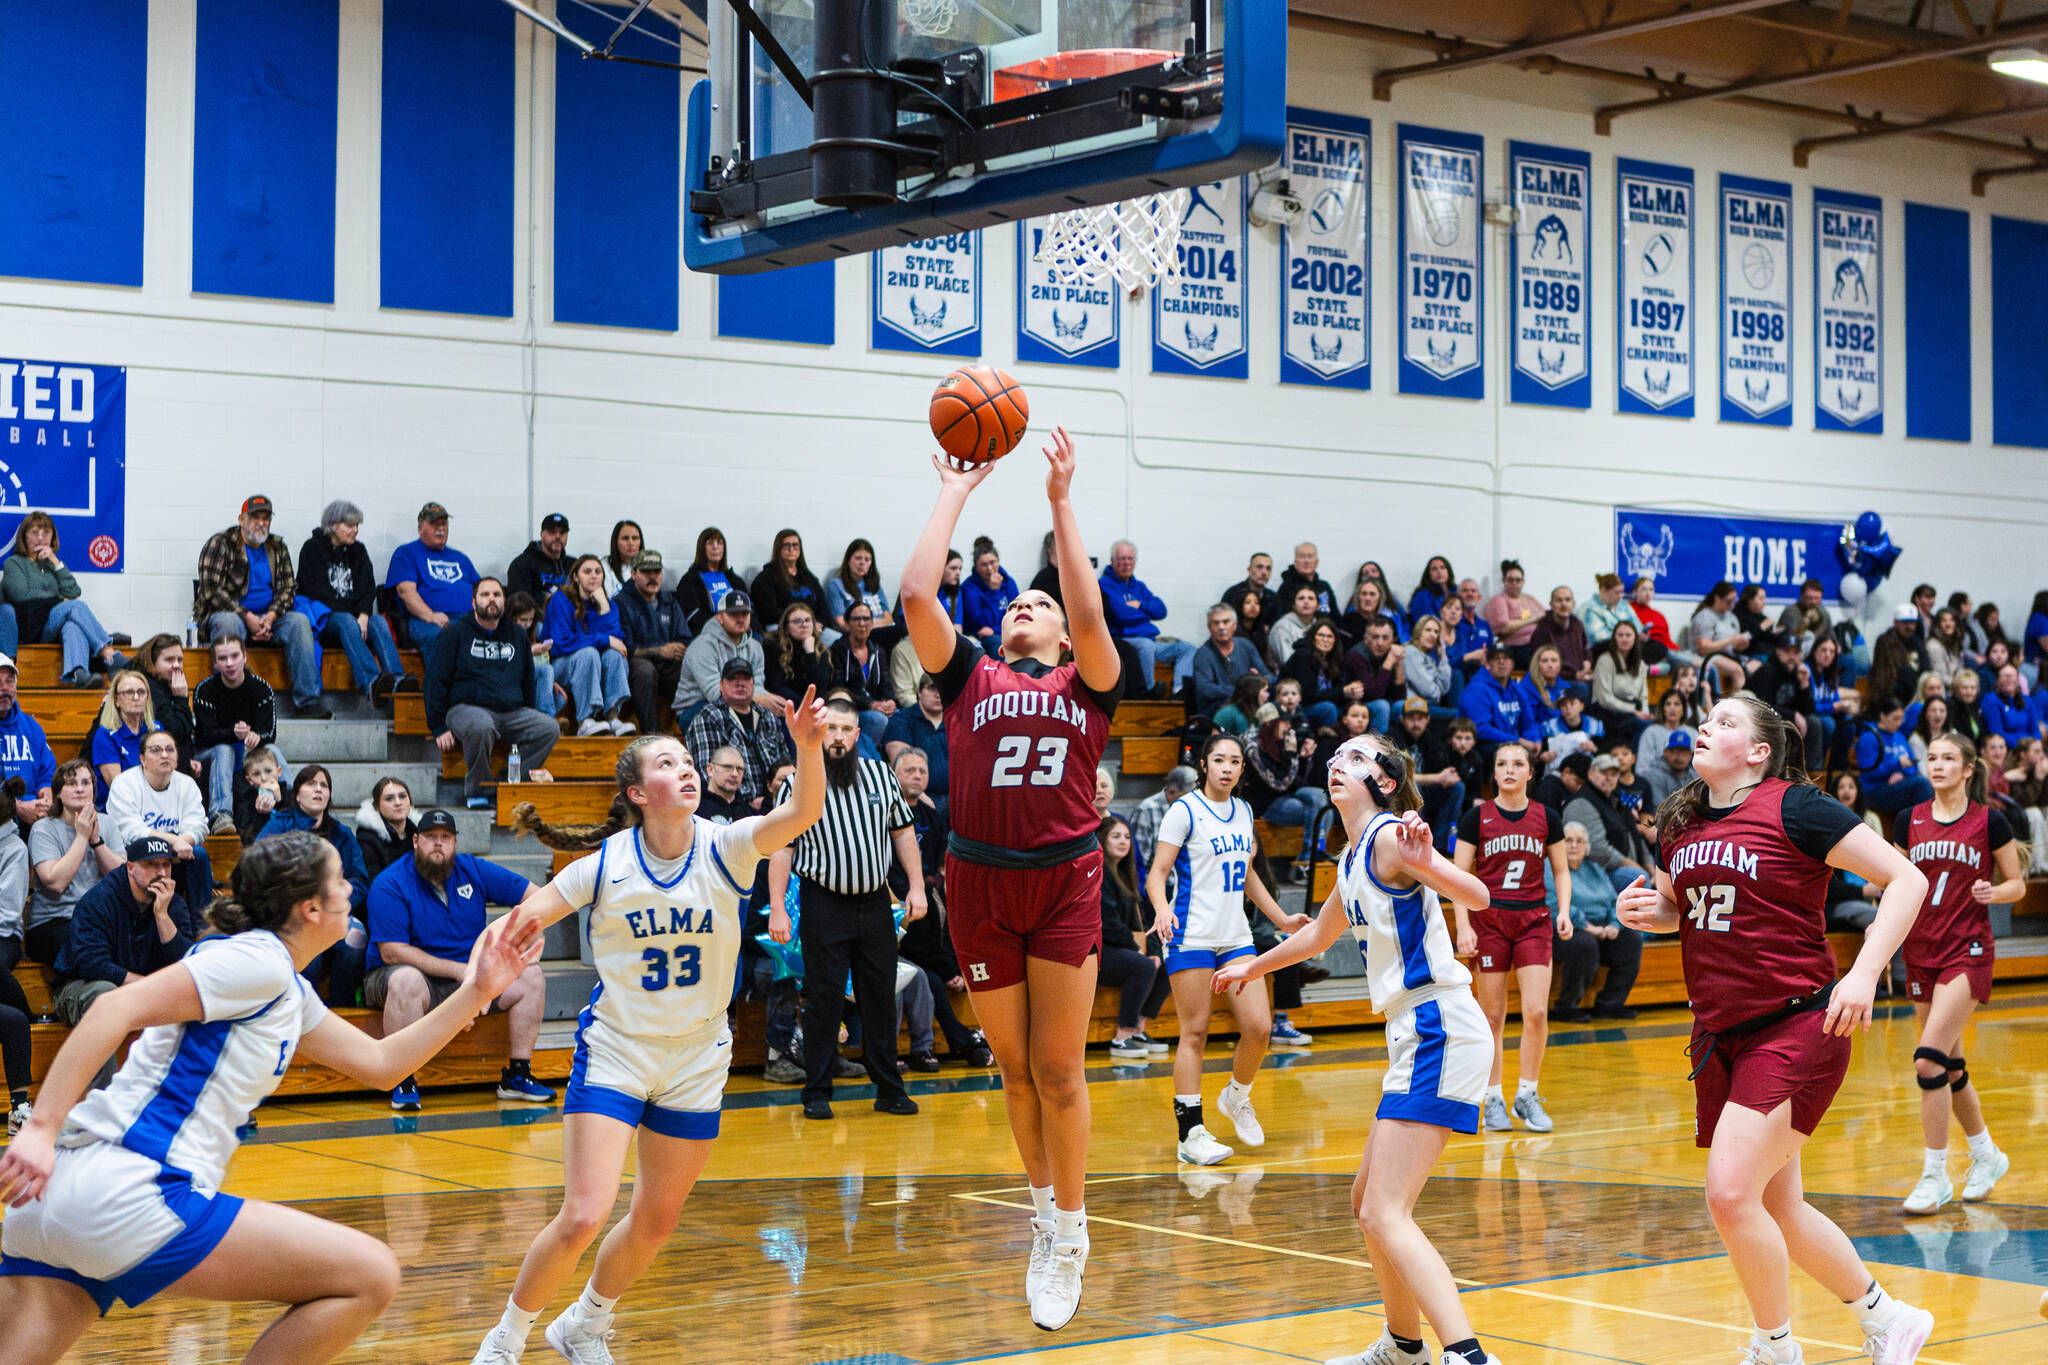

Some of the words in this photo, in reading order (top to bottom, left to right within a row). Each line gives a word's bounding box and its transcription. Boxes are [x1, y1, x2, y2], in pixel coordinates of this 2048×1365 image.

[1293, 133, 1363, 169] ELMA
[1411, 151, 1474, 183] ELMA
[1522, 166, 1582, 198] ELMA
[1628, 184, 1686, 216] ELMA
[1729, 198, 1785, 229] ELMA
[1823, 212, 1875, 242] ELMA
[906, 255, 954, 274] STATE
[1291, 258, 1362, 296] 2002
[888, 271, 919, 288] 2ND
[924, 276, 970, 293] PLACE
[1032, 285, 1061, 301] 2ND
[1066, 287, 1109, 306] PLACE
[1181, 284, 1224, 300] STATE
[1412, 266, 1472, 302] 1970
[1523, 280, 1580, 314] 1989
[1164, 298, 1240, 319] CHAMPIONS
[1306, 297, 1348, 314] STATE
[1424, 303, 1462, 318] STATE
[1630, 298, 1685, 332] 1997
[1293, 312, 1318, 327] 2ND
[1323, 314, 1361, 331] PLACE
[1411, 316, 1434, 331] 2ND
[1438, 319, 1474, 335] PLACE
[1534, 314, 1570, 330] STATE
[1732, 309, 1784, 342] 1998
[1826, 320, 1875, 353] 1992
[1522, 328, 1544, 342] 2ND
[1548, 330, 1581, 346] PLACE
[1642, 334, 1676, 349] STATE
[1742, 344, 1774, 358] STATE
[1627, 347, 1688, 365] CHAMPIONS
[1729, 358, 1786, 375] CHAMPIONS
[1847, 370, 1876, 384] PLACE
[1724, 535, 1808, 585] HOME
[972, 690, 1086, 735] HOQUIAM
[991, 736, 1069, 787] 23
[148, 841, 168, 853] NDC
[1484, 834, 1544, 858] HOQUIAM
[1910, 840, 1982, 870] HOQUIAM
[1222, 860, 1246, 892] 12
[1502, 860, 1526, 890] 2
[1670, 840, 1760, 885] HOQUIAM
[1931, 871, 1950, 906] 1
[625, 907, 714, 939] ELMA
[1686, 884, 1736, 932] 42
[641, 945, 701, 992] 33
[969, 962, 990, 982] H
[1482, 956, 1494, 968] H
